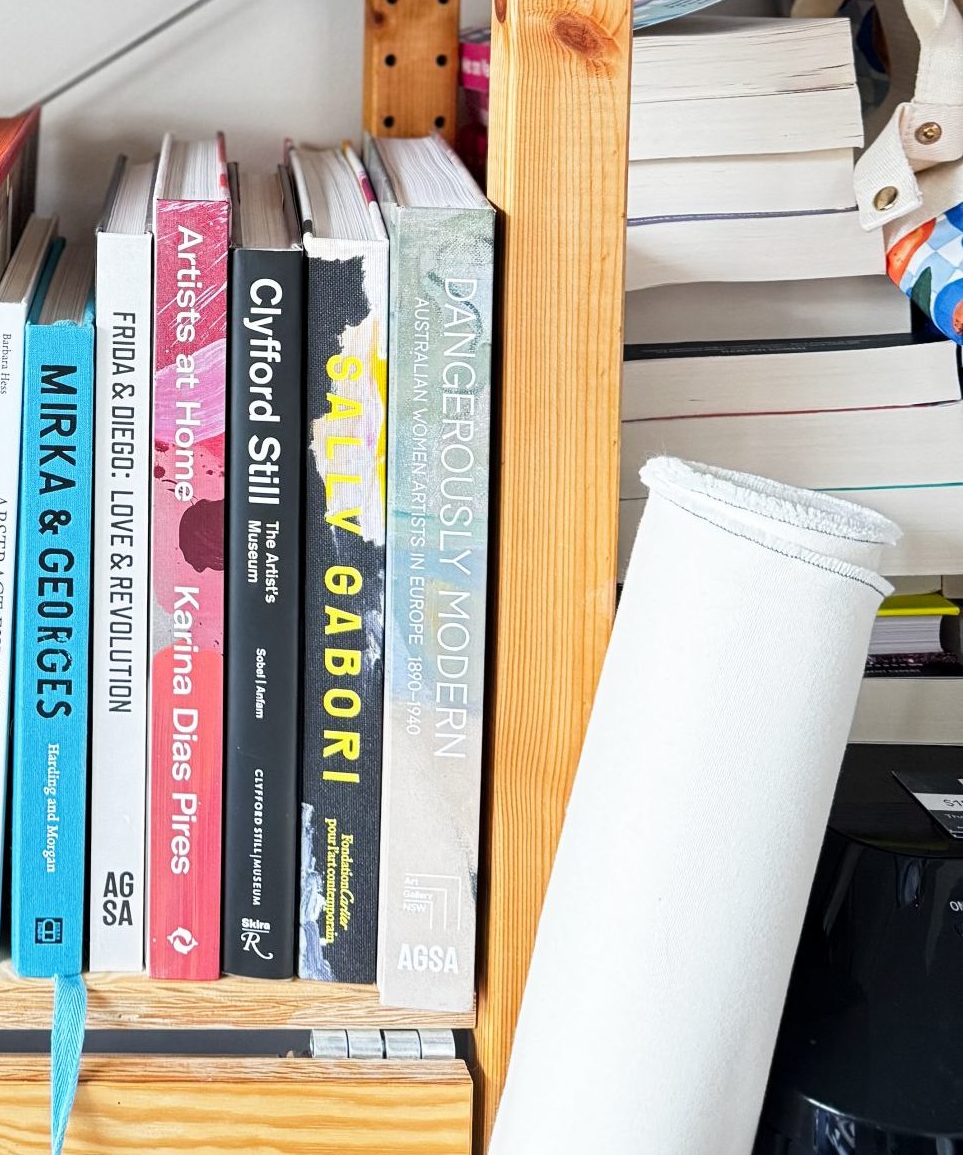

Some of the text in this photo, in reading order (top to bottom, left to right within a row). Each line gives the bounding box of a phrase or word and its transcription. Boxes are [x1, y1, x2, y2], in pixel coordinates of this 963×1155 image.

[0, 333, 12, 395] Barbara Hess
[174, 224, 204, 503] Artists at Home
[412, 297, 430, 403] AUSTRALIAN
[243, 277, 283, 505] Clyfford Still
[411, 408, 428, 480] WOMEN
[37, 364, 78, 720] MIRKA & GEORGES
[109, 312, 136, 713] FRIDA & DIEGO: LOVE & REVOLUTION
[409, 483, 426, 548] ARTISTS
[433, 277, 477, 759] DANGEROUSLY MODERN
[247, 520, 261, 583] Museum
[265, 521, 280, 604] The Artist's
[322, 354, 364, 784] SALLY GABORI
[409, 556, 425, 570] IN
[408, 575, 425, 645] EUROPE
[255, 648, 267, 719] Sobel Anfam
[170, 585, 200, 876] Karina Dias Pires
[41, 743, 60, 873] Harding and Morgan
[254, 768, 264, 825] CLYFFORD
[103, 900, 134, 926] SA
[104, 871, 134, 898] AG
[323, 818, 338, 944] pour contemporain
[339, 834, 355, 931] Fondation Cartier
[241, 917, 271, 930] Skira
[397, 943, 458, 974] AGSA
